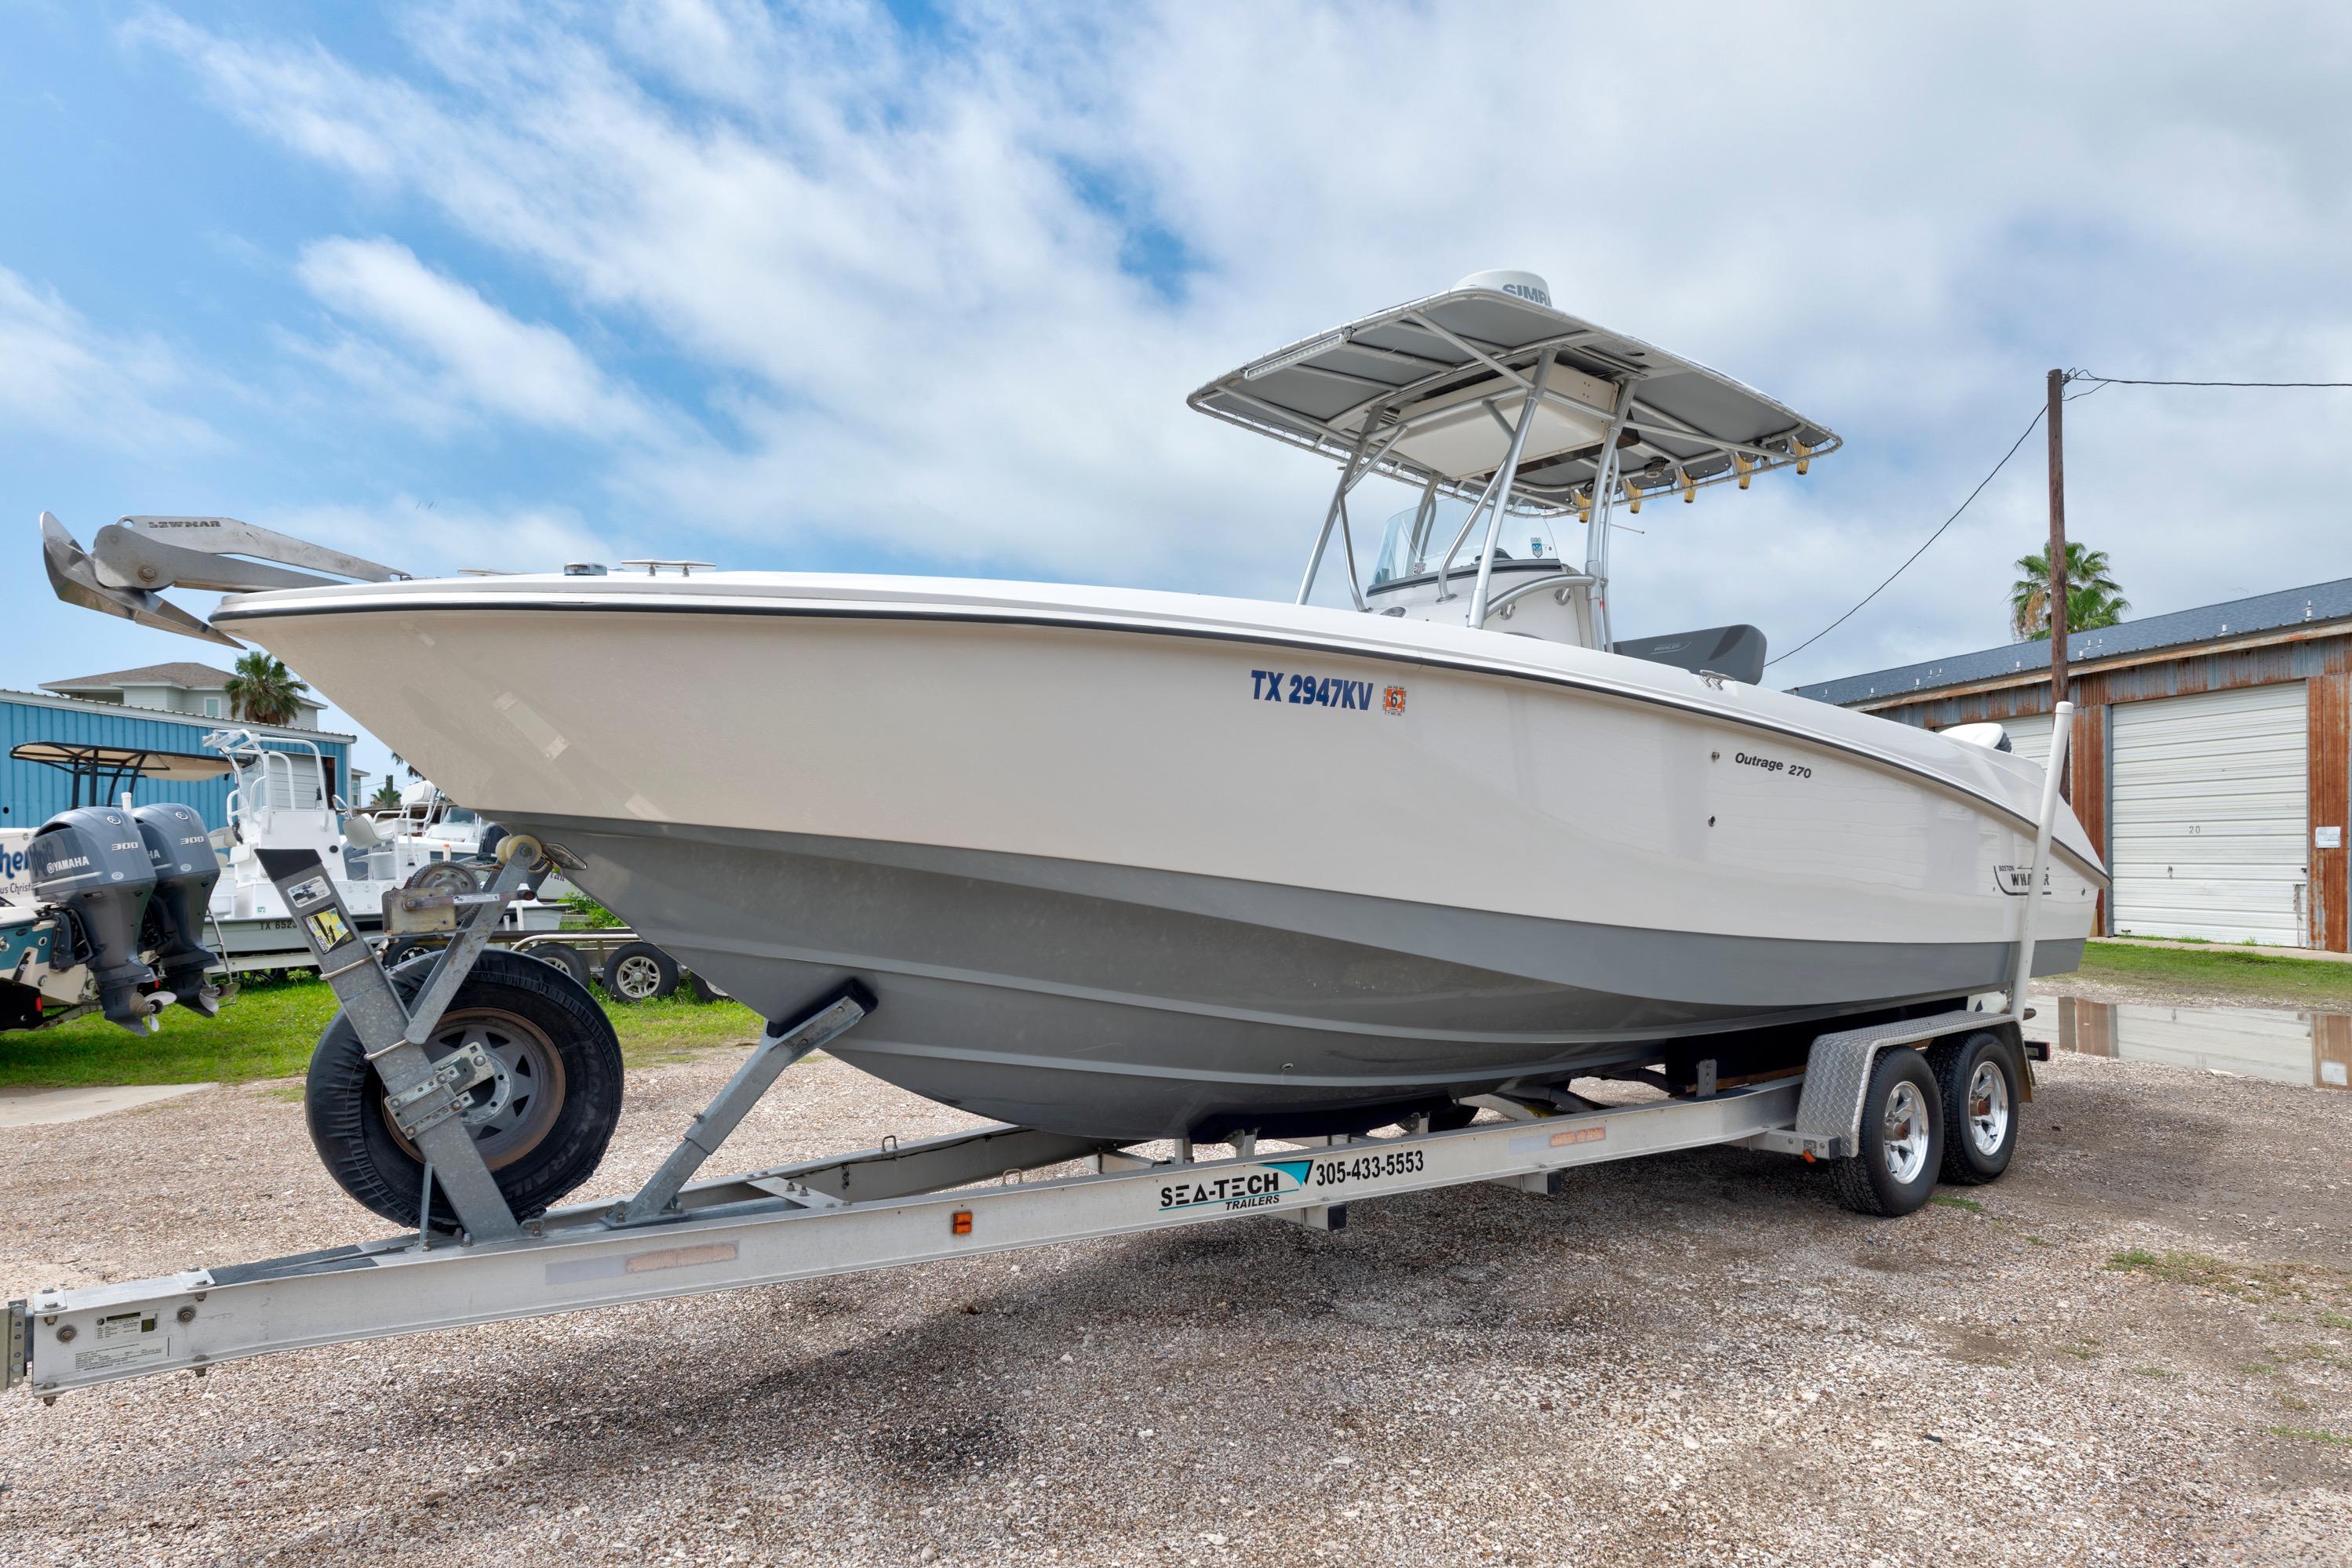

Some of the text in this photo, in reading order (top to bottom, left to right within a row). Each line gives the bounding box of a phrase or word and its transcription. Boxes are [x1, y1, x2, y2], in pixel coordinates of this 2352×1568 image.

[1251, 670, 1284, 702] TX
[1288, 675, 1374, 711] 2947KV
[1735, 752, 1811, 778] Outrage 270
[2189, 825, 2201, 834] 20
[111, 842, 139, 851] 300
[180, 836, 204, 845] 300
[53, 856, 89, 871] YAMAHA
[260, 921, 271, 930] TX
[1316, 1150, 1424, 1186] 305-433-5553
[1160, 1173, 1279, 1206] SEA-TECH
[1225, 1195, 1280, 1211] TRAILERS
